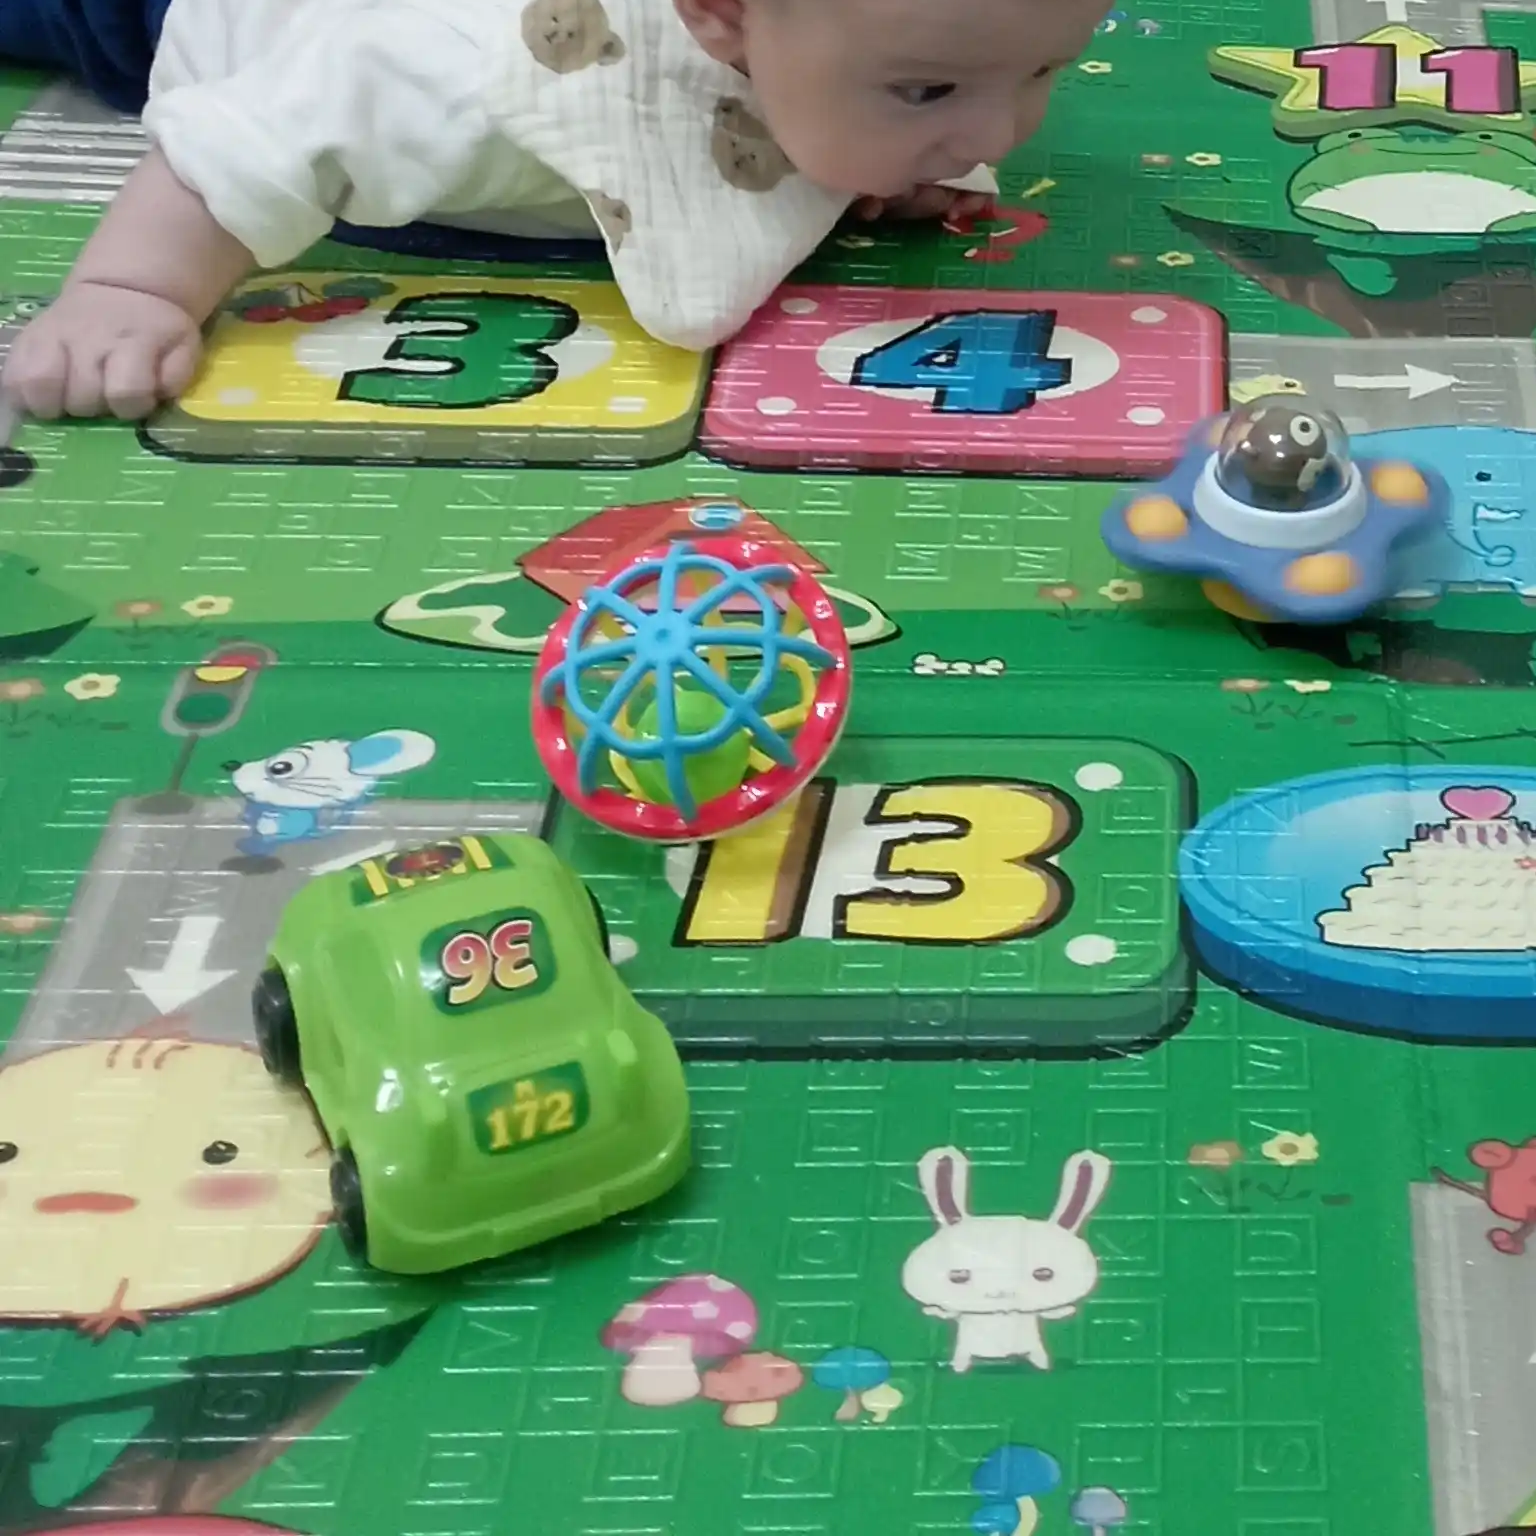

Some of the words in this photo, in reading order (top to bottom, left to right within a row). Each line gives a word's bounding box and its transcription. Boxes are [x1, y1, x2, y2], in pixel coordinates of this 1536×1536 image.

[1294, 42, 1522, 114] 11
[337, 291, 580, 409] 3
[849, 308, 1074, 414] 4
[671, 774, 1084, 947] 13
[487, 1090, 575, 1152] 172
